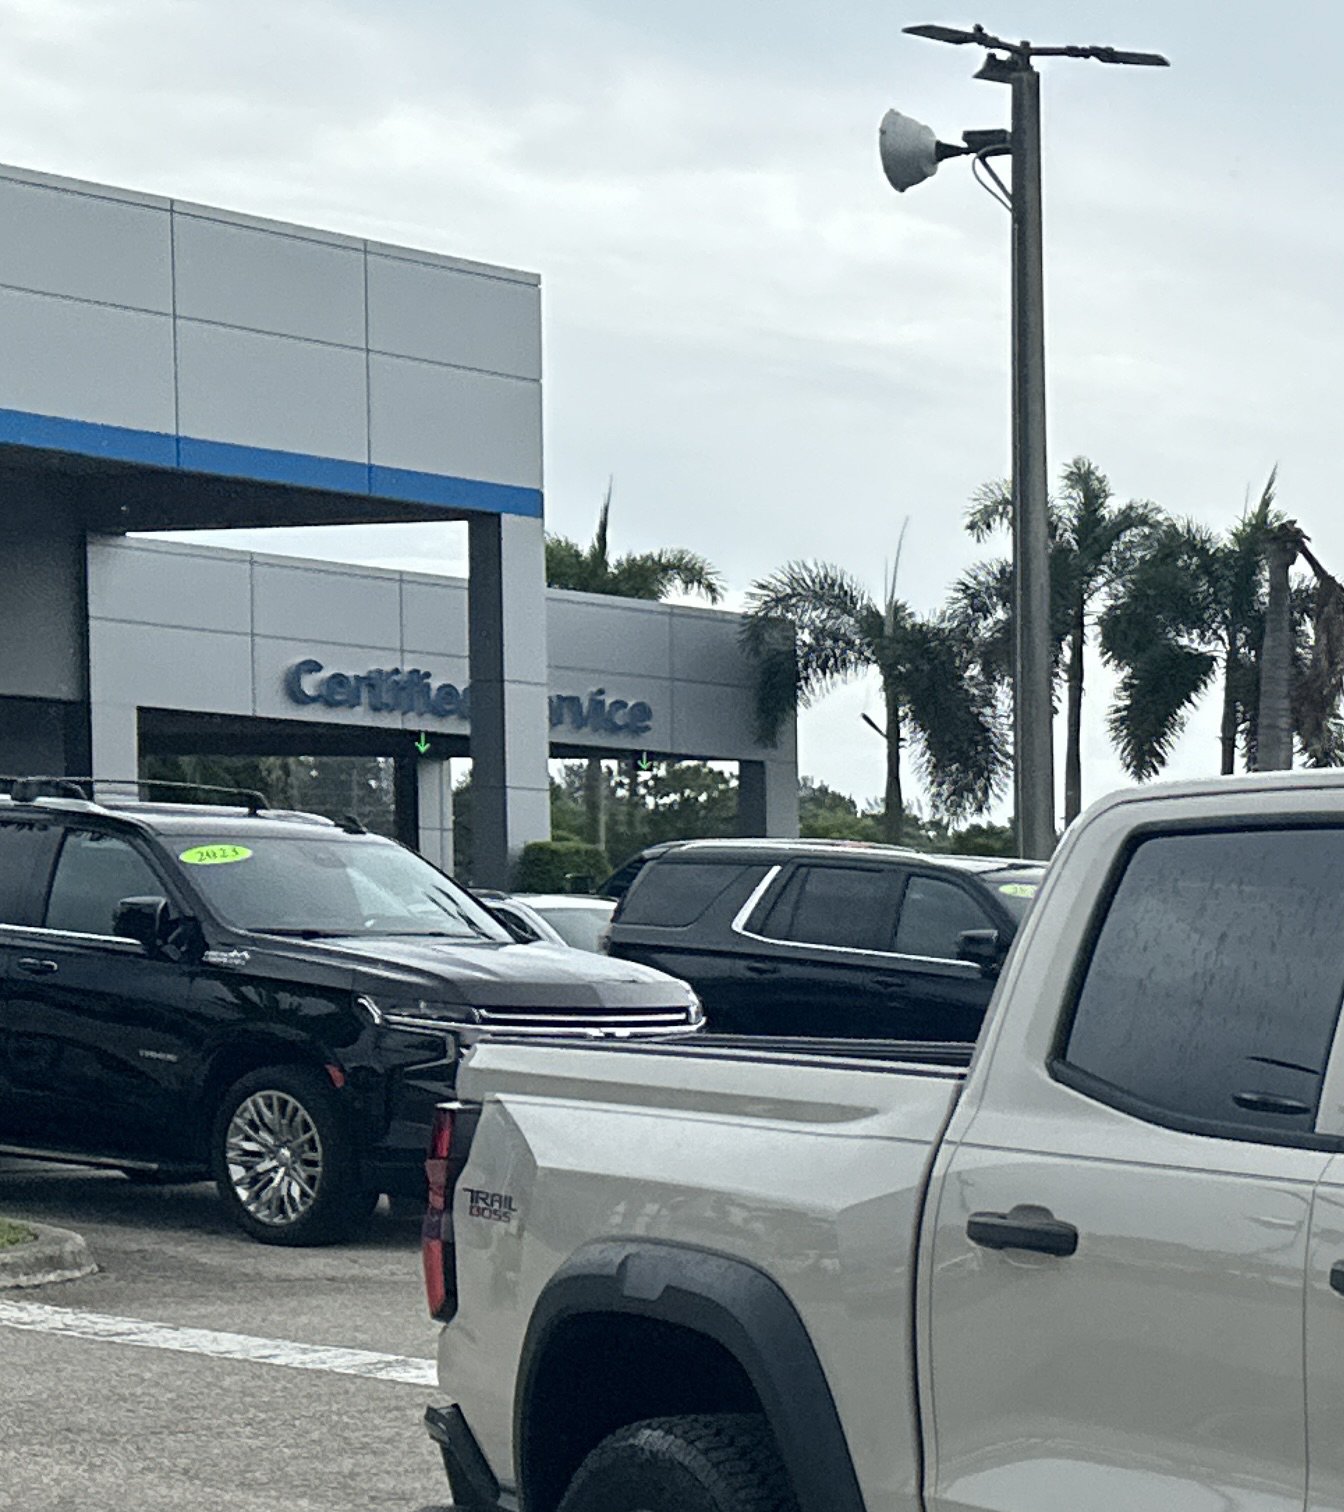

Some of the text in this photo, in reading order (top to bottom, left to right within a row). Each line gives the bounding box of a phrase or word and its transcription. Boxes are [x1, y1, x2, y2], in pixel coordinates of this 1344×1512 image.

[286, 659, 653, 735] Certifie rvice
[462, 1187, 518, 1212] TRAIL
[469, 1205, 511, 1223] BOSS
